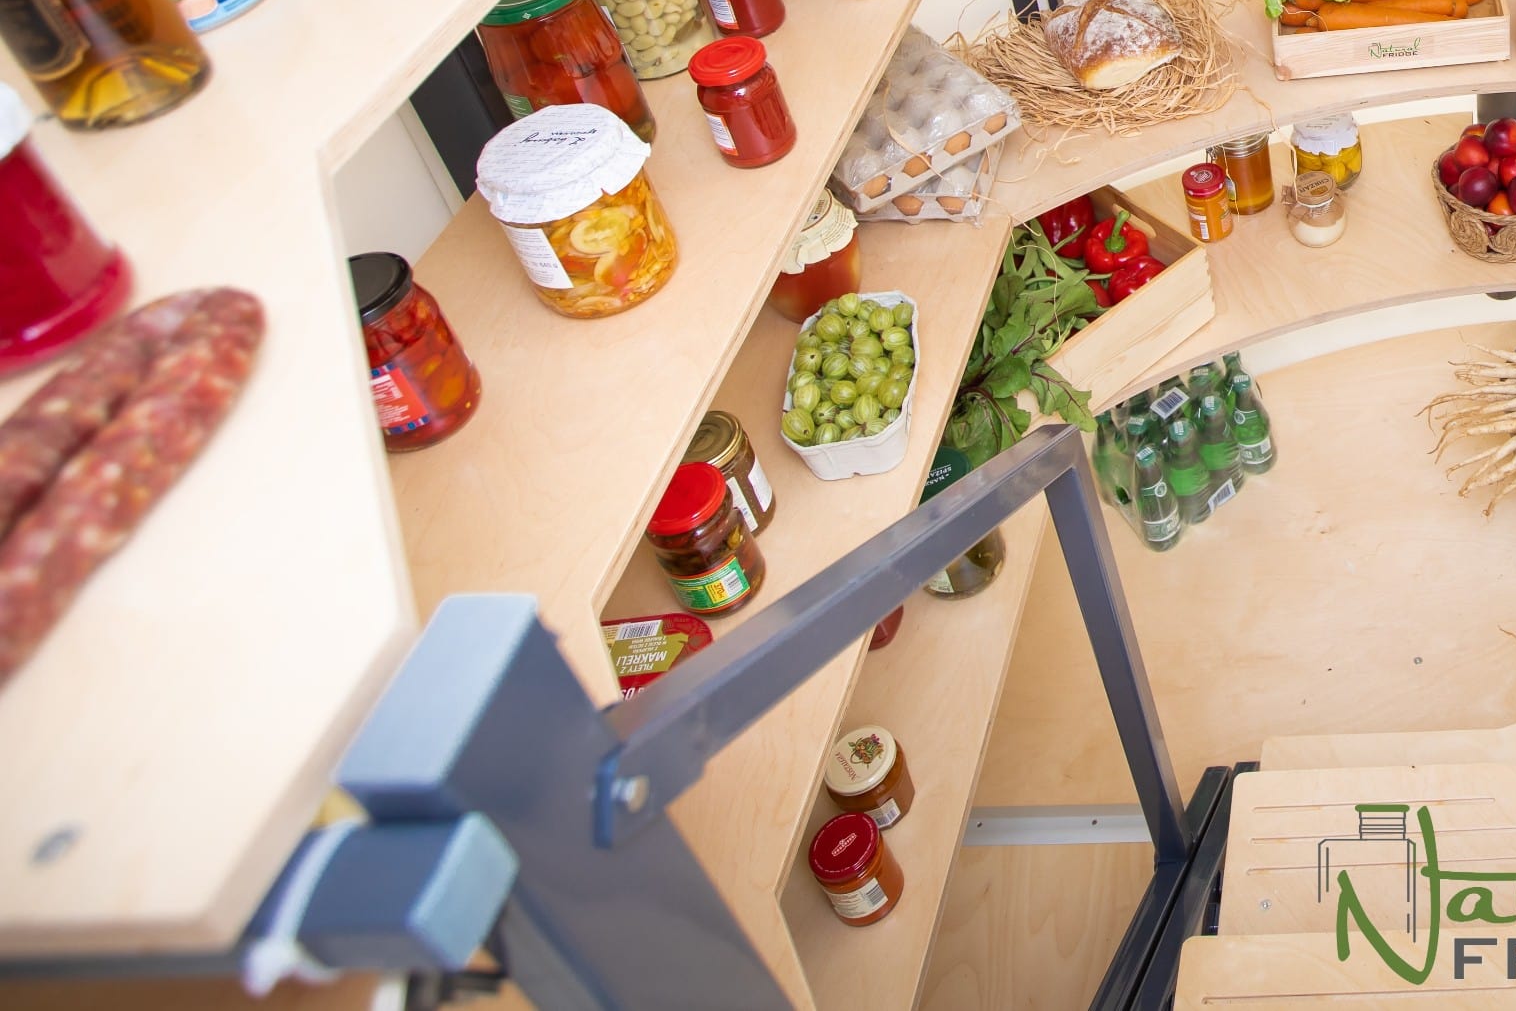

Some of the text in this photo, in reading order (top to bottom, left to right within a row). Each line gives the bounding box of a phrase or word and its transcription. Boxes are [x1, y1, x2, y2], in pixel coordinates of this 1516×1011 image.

[1370, 37, 1421, 59] Natural
[1382, 50, 1419, 58] FRIDGE
[616, 650, 668, 667] MAKRELI
[627, 663, 654, 674] FILETY
